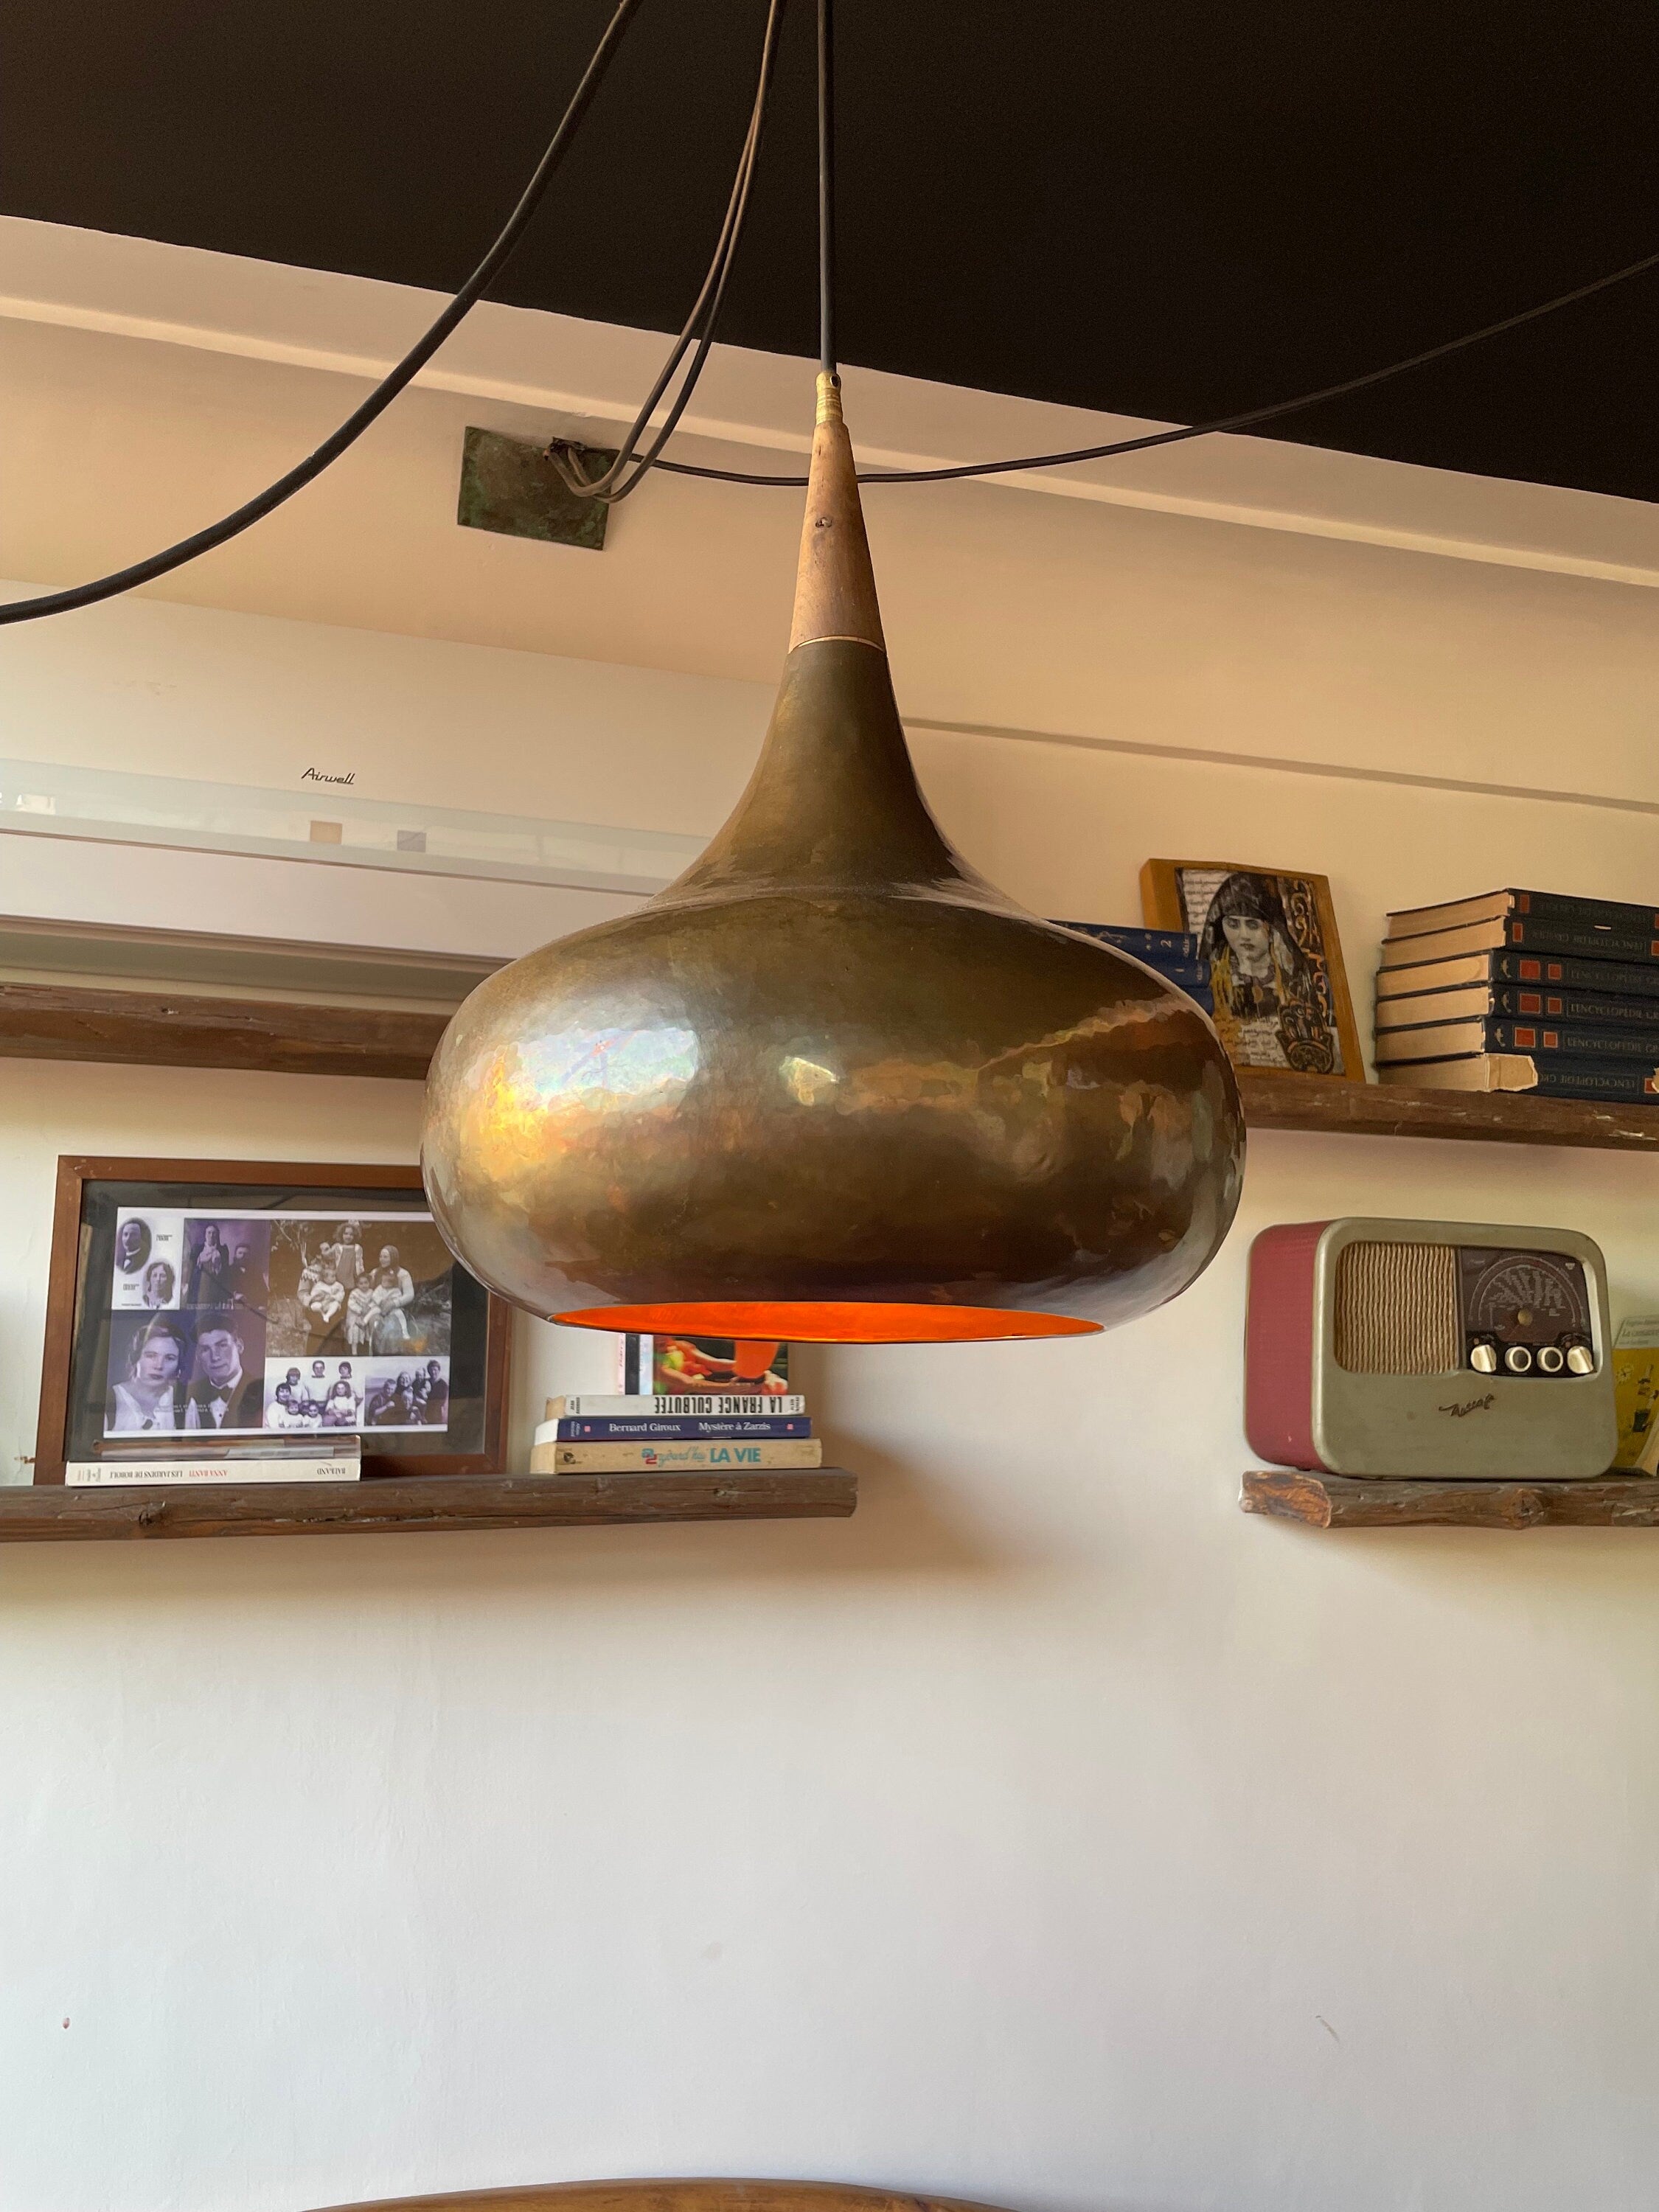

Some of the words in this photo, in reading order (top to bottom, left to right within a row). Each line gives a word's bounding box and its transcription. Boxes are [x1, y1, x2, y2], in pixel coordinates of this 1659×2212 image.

[301, 768, 355, 785] Airwell
[1161, 939, 1172, 948] 2
[718, 1397, 762, 1414] FRANCE
[769, 1397, 783, 1413] LA
[609, 1423, 647, 1432] Bernard
[649, 1423, 682, 1432] Giroux
[698, 1422, 734, 1433] Mystère
[736, 1422, 742, 1430] à
[743, 1422, 771, 1431] Zarzis
[709, 1447, 731, 1463] LA
[734, 1447, 762, 1463] VIE
[144, 1470, 171, 1478] JARDINS
